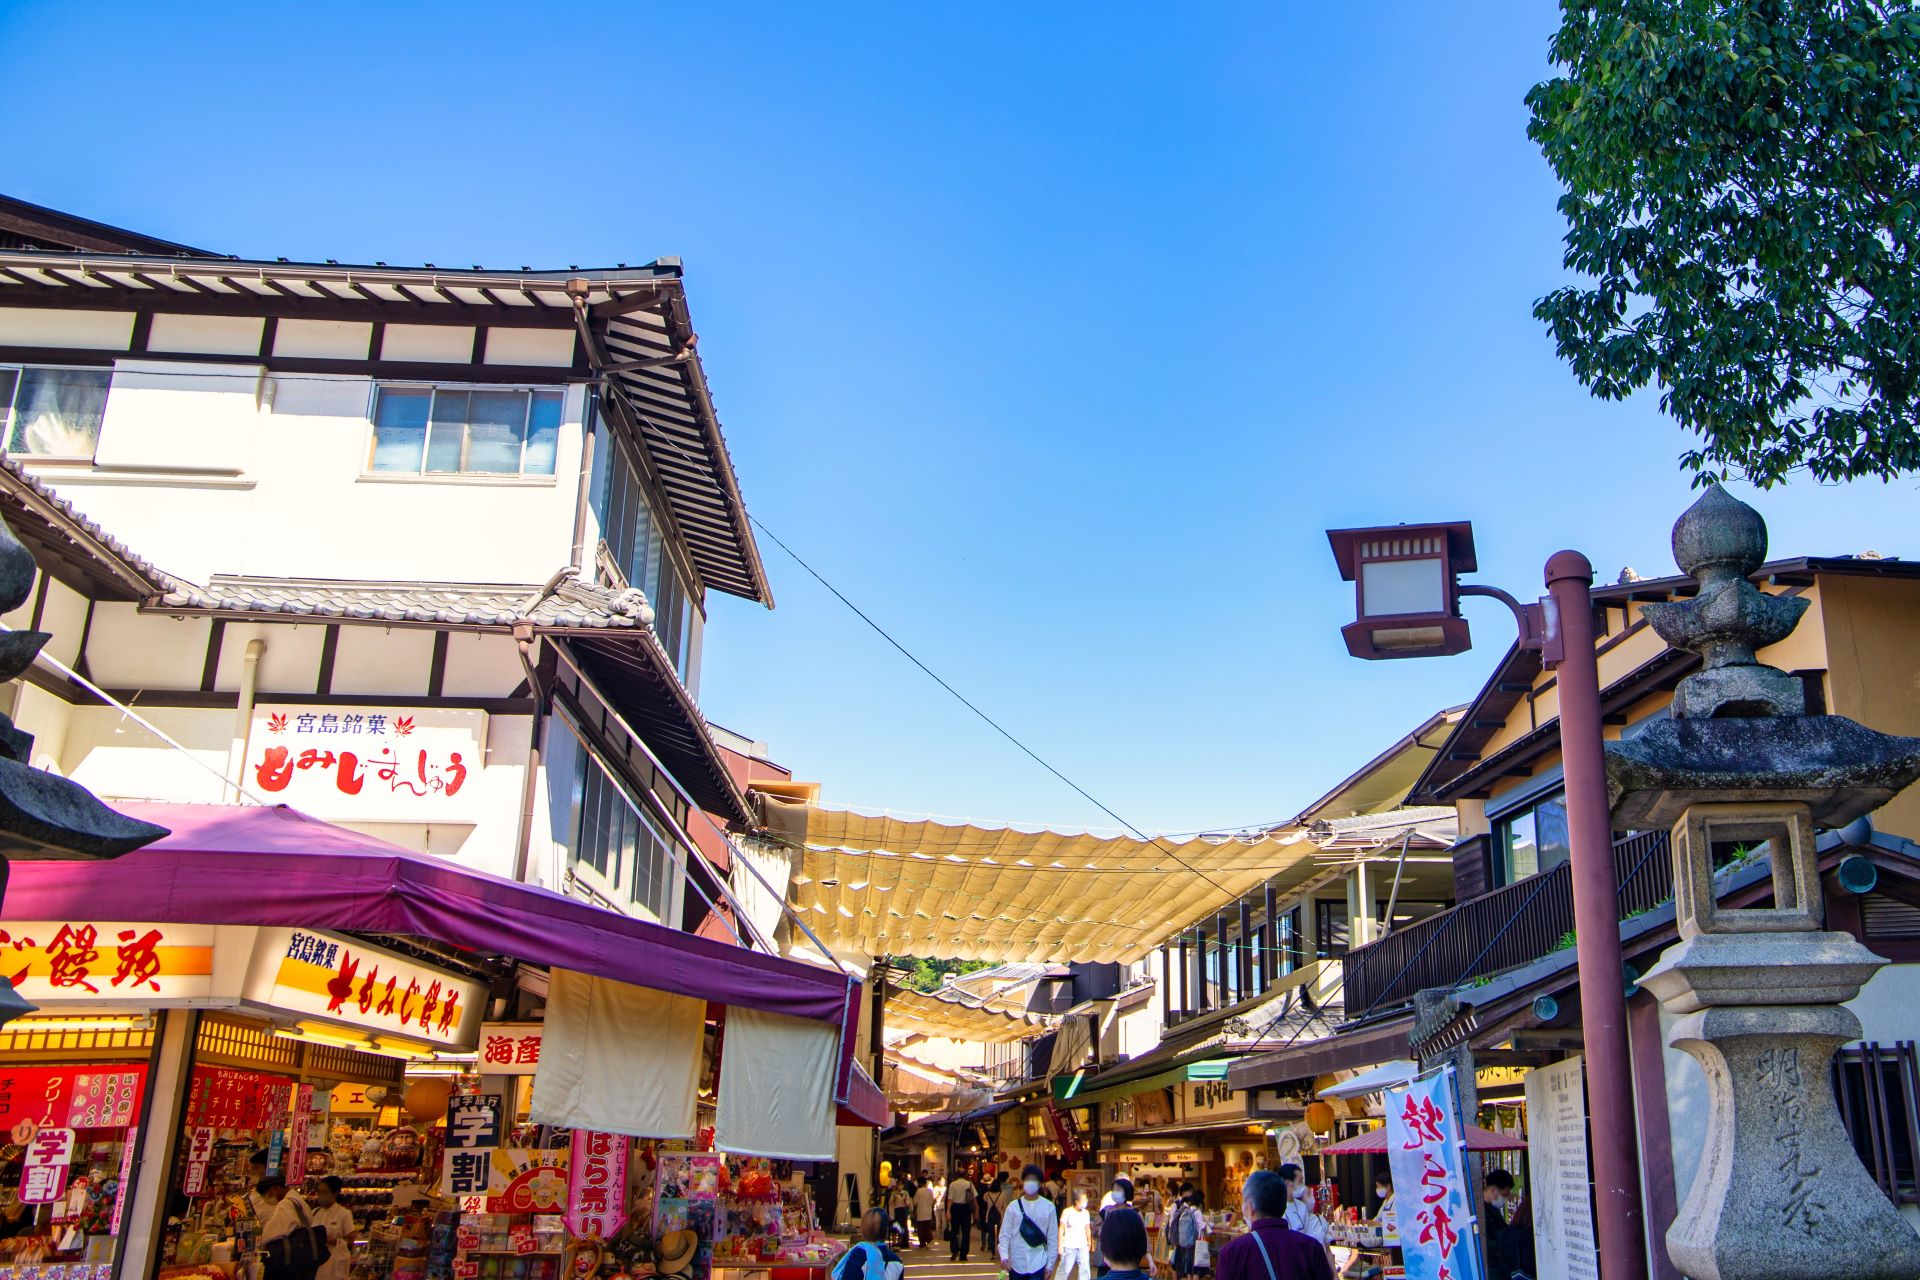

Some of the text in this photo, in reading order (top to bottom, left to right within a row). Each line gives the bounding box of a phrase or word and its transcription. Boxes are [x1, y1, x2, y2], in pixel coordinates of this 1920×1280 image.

[297, 713, 388, 735] 宮島銘菓
[254, 745, 467, 797] もみじまんじゅう
[286, 932, 339, 969] 宮島銘菓
[358, 964, 460, 1037] もみじ饅頭
[39, 1077, 63, 1127] クリーム
[25, 1130, 68, 1201] 学割
[185, 1130, 212, 1196] 学割
